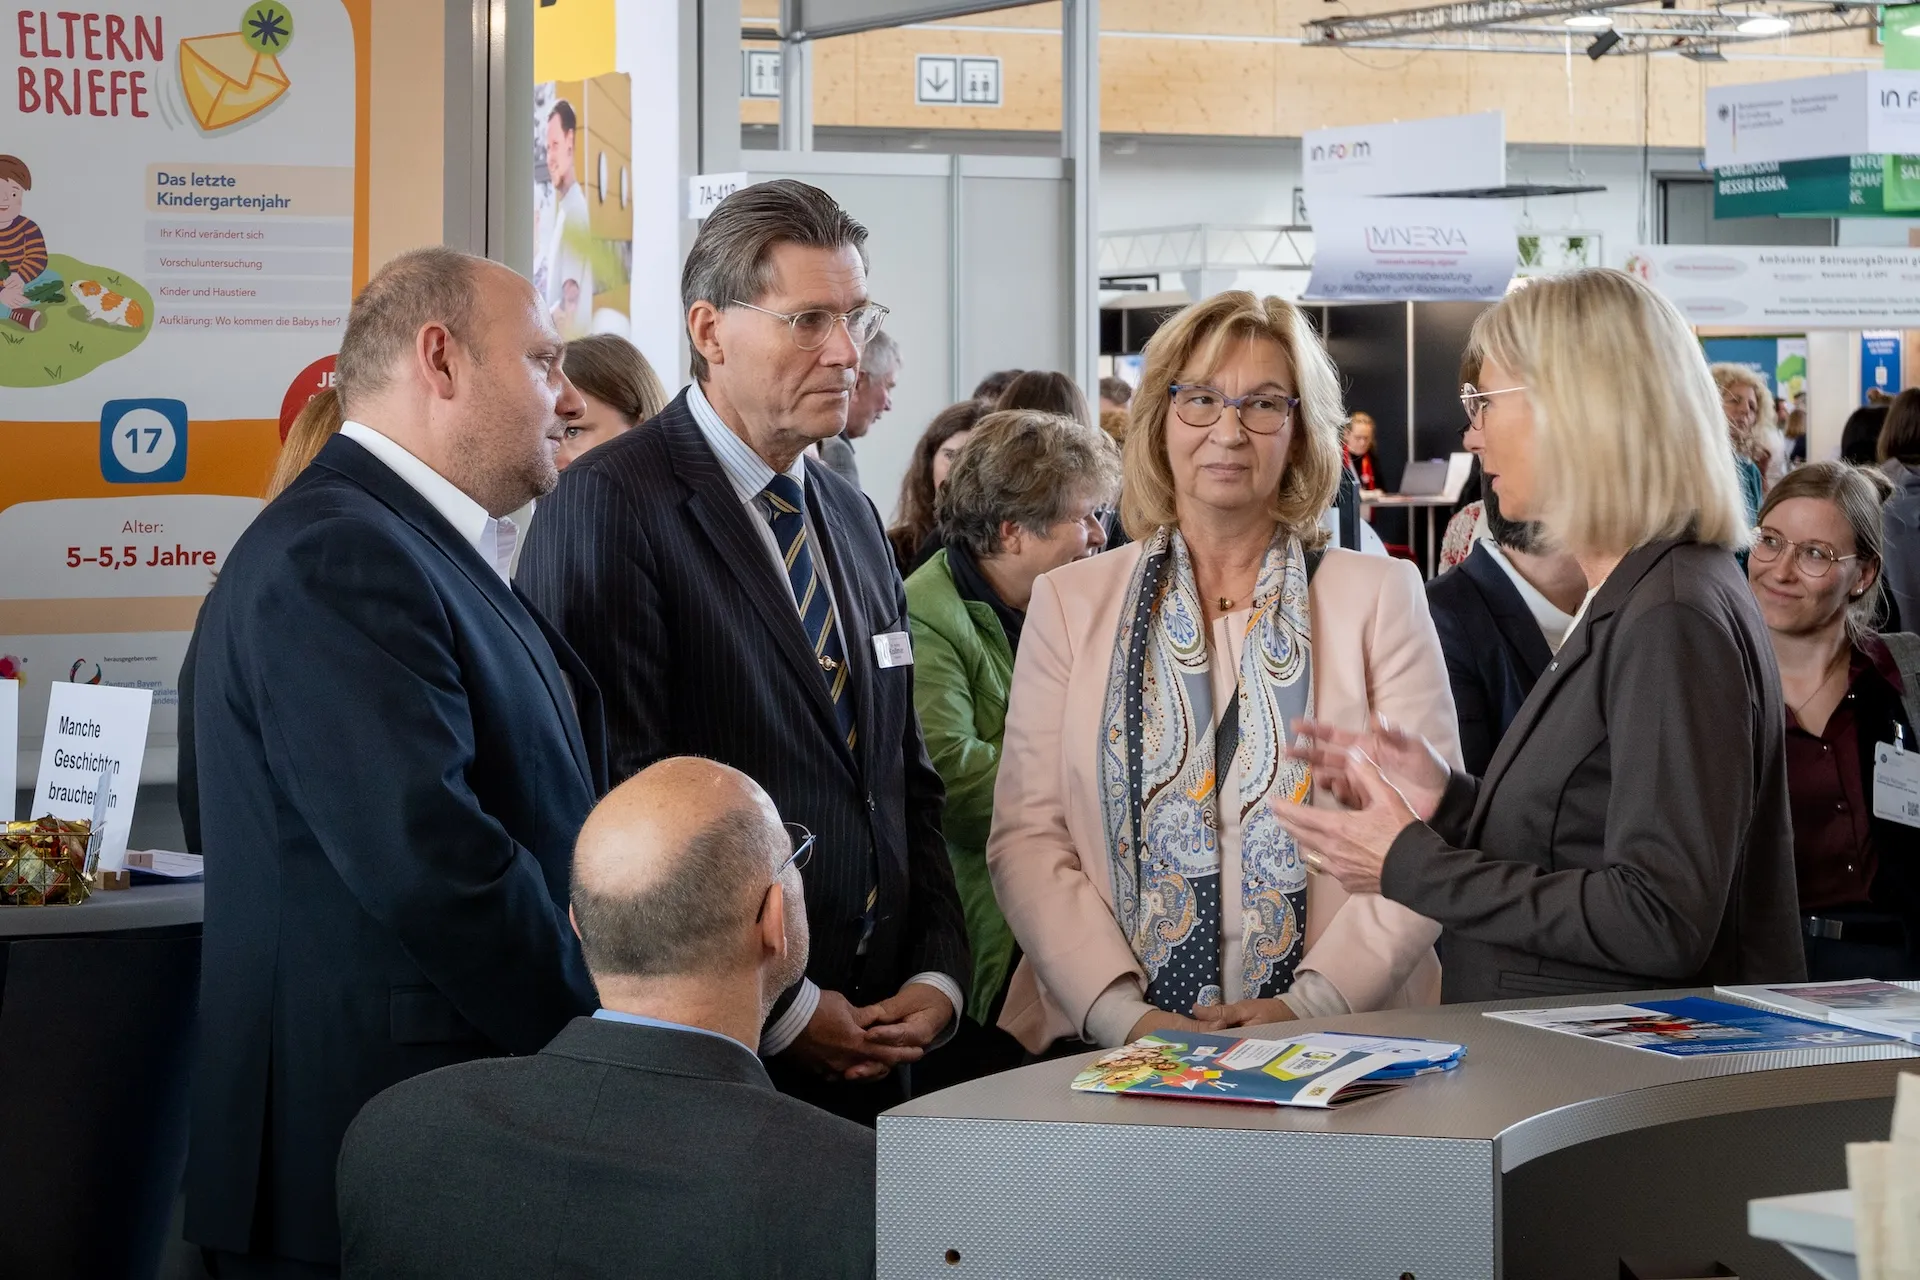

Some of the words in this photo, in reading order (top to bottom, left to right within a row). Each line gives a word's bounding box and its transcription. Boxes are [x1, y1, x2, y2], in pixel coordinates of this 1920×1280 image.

[18, 11, 164, 62] ELTERN
[18, 66, 149, 118] BRIEFE
[157, 172, 187, 187] Das
[191, 172, 236, 188] letzte
[1719, 178, 1755, 196] BESSER
[157, 192, 292, 212] Kindergartenjahr
[160, 229, 173, 238] Ihr
[175, 229, 197, 239] Kind
[198, 230, 244, 240] verändert
[246, 230, 264, 240] sich
[159, 258, 263, 271] Vorschuluntersuchung
[159, 287, 191, 297] Kinder
[193, 287, 211, 297] und
[212, 287, 257, 297] Haustiere
[159, 315, 213, 328] Aufklärung:
[215, 316, 231, 325] Wo
[233, 316, 273, 326] kommen
[275, 316, 290, 326] die
[292, 317, 320, 328] Babys
[321, 317, 341, 327] her?
[124, 428, 162, 454] 17
[121, 520, 164, 534] Alter:
[146, 544, 217, 567] Jahre
[136, 679, 162, 689] Bayern
[152, 688, 177, 697] oziales
[58, 715, 101, 738] Manche
